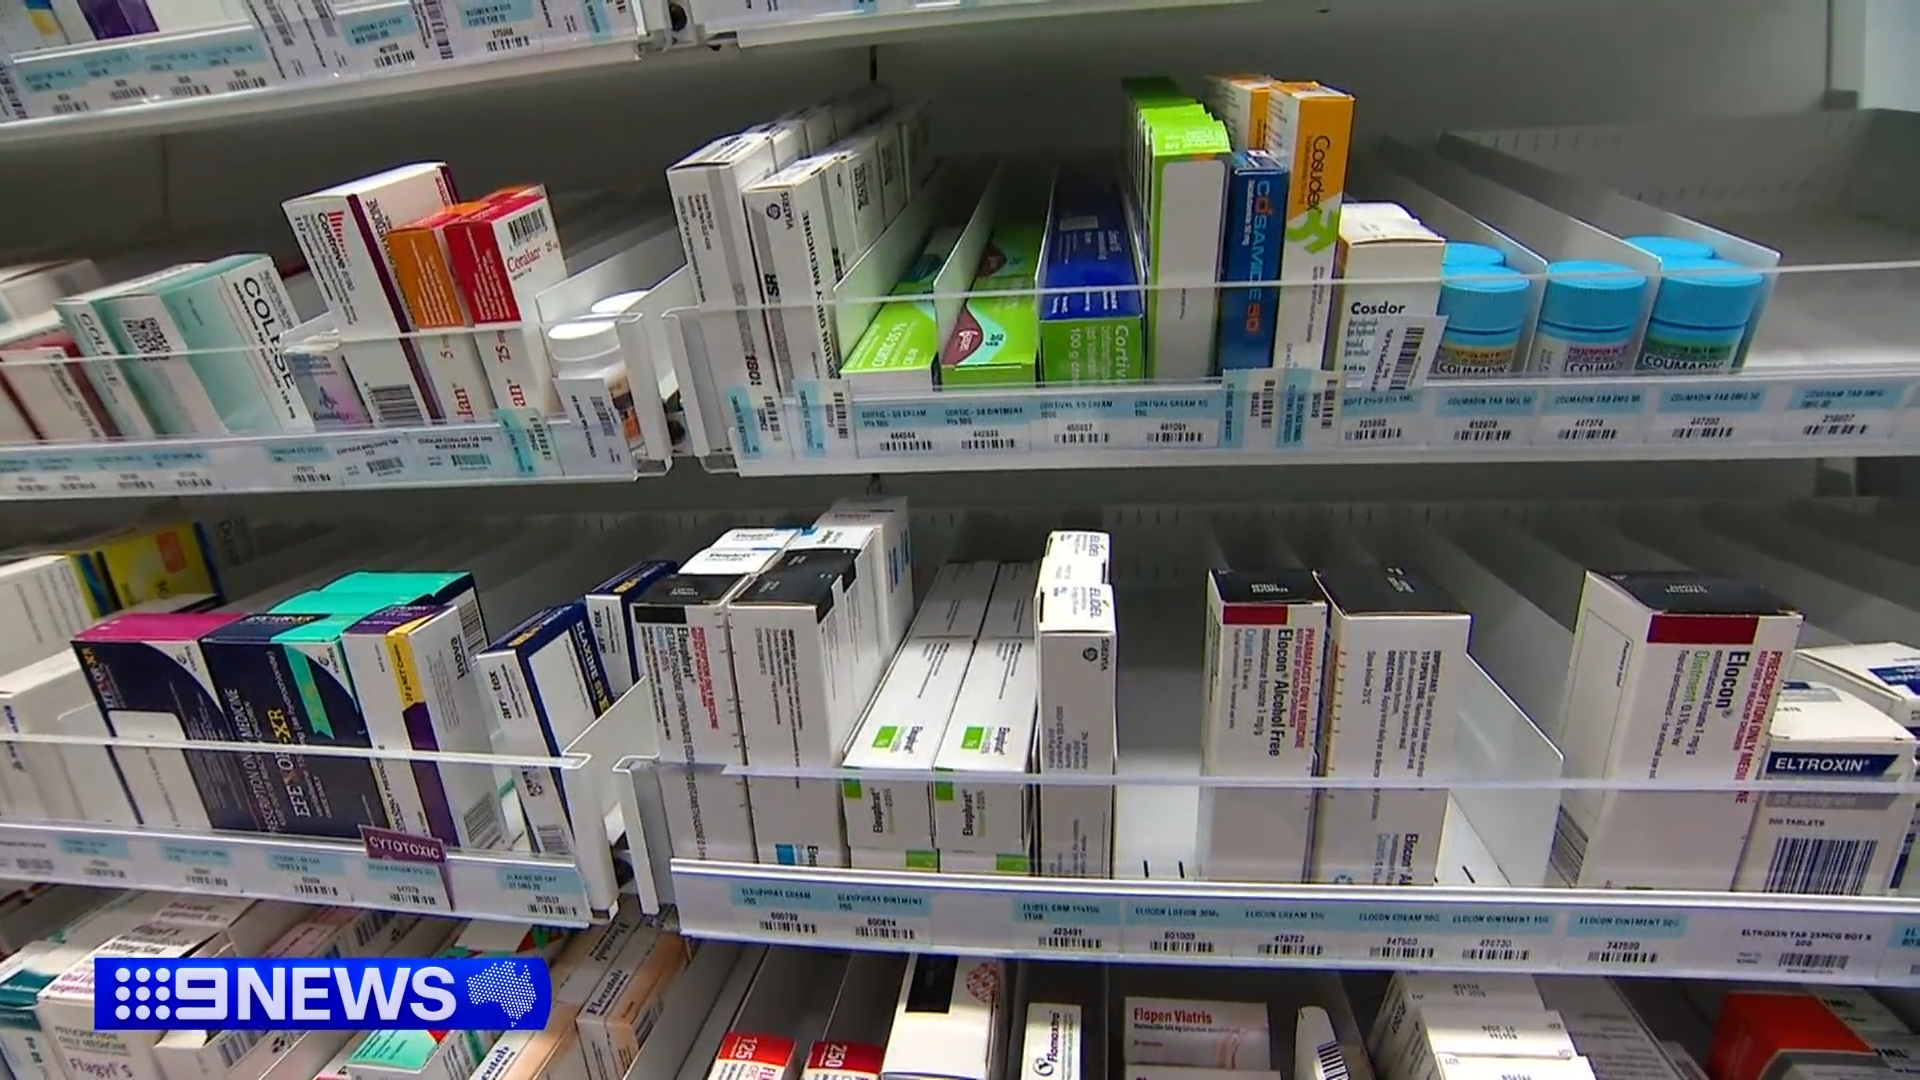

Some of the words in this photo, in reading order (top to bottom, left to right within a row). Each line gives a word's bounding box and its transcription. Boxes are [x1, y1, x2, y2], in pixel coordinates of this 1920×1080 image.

[1306, 134, 1331, 212] Cosudex
[779, 192, 793, 230] VIATRIS
[316, 211, 346, 270] Contrave
[801, 209, 822, 287] MEDICINE
[506, 247, 541, 273] Coralan
[763, 272, 781, 298] SR
[1351, 302, 1406, 315] Cosdor
[243, 276, 296, 391] COLESE
[1089, 586, 1102, 619] ELIDEL
[575, 620, 600, 681] ELAXINE
[1259, 627, 1271, 678] mometasone
[1301, 627, 1314, 683] PHARMACIST
[1682, 648, 1709, 704] Ointment
[1703, 648, 1723, 701] mometasone
[1754, 650, 1783, 723] PRESCRIPTION
[1257, 679, 1268, 707] furoate
[1271, 679, 1289, 727] Alcohol
[1299, 685, 1309, 707] ONLY
[1295, 709, 1307, 748] MEDICINE
[1748, 721, 1761, 749] ONLY
[1268, 729, 1285, 757] Free
[871, 787, 882, 834] Eleuphrat
[962, 788, 973, 837] Eleuphrat
[1786, 818, 1826, 827] TABLETS
[368, 834, 441, 861] CYTOTOXIC
[883, 897, 923, 906] OINTMENT
[1023, 903, 1049, 912] ELIDEL
[1135, 907, 1161, 917] ELOCON
[1163, 909, 1198, 918] LOTION
[1245, 910, 1275, 919] ELOCON
[1277, 911, 1308, 920] CREAM
[1358, 912, 1391, 922] ELOCON
[1393, 913, 1422, 922] CREAM
[1452, 915, 1485, 925] ELOCON
[1486, 915, 1532, 925] OINTMENT
[1579, 917, 1613, 927] ELOCON
[1614, 918, 1660, 927] OINTMENT
[1790, 930, 1809, 939] TAB
[1133, 1007, 1173, 1024] Flopen
[1174, 1009, 1213, 1025] Viatris
[735, 1036, 758, 1059] 125
[1046, 1011, 1061, 1064] Flomaxtra
[824, 1043, 849, 1067] 250
